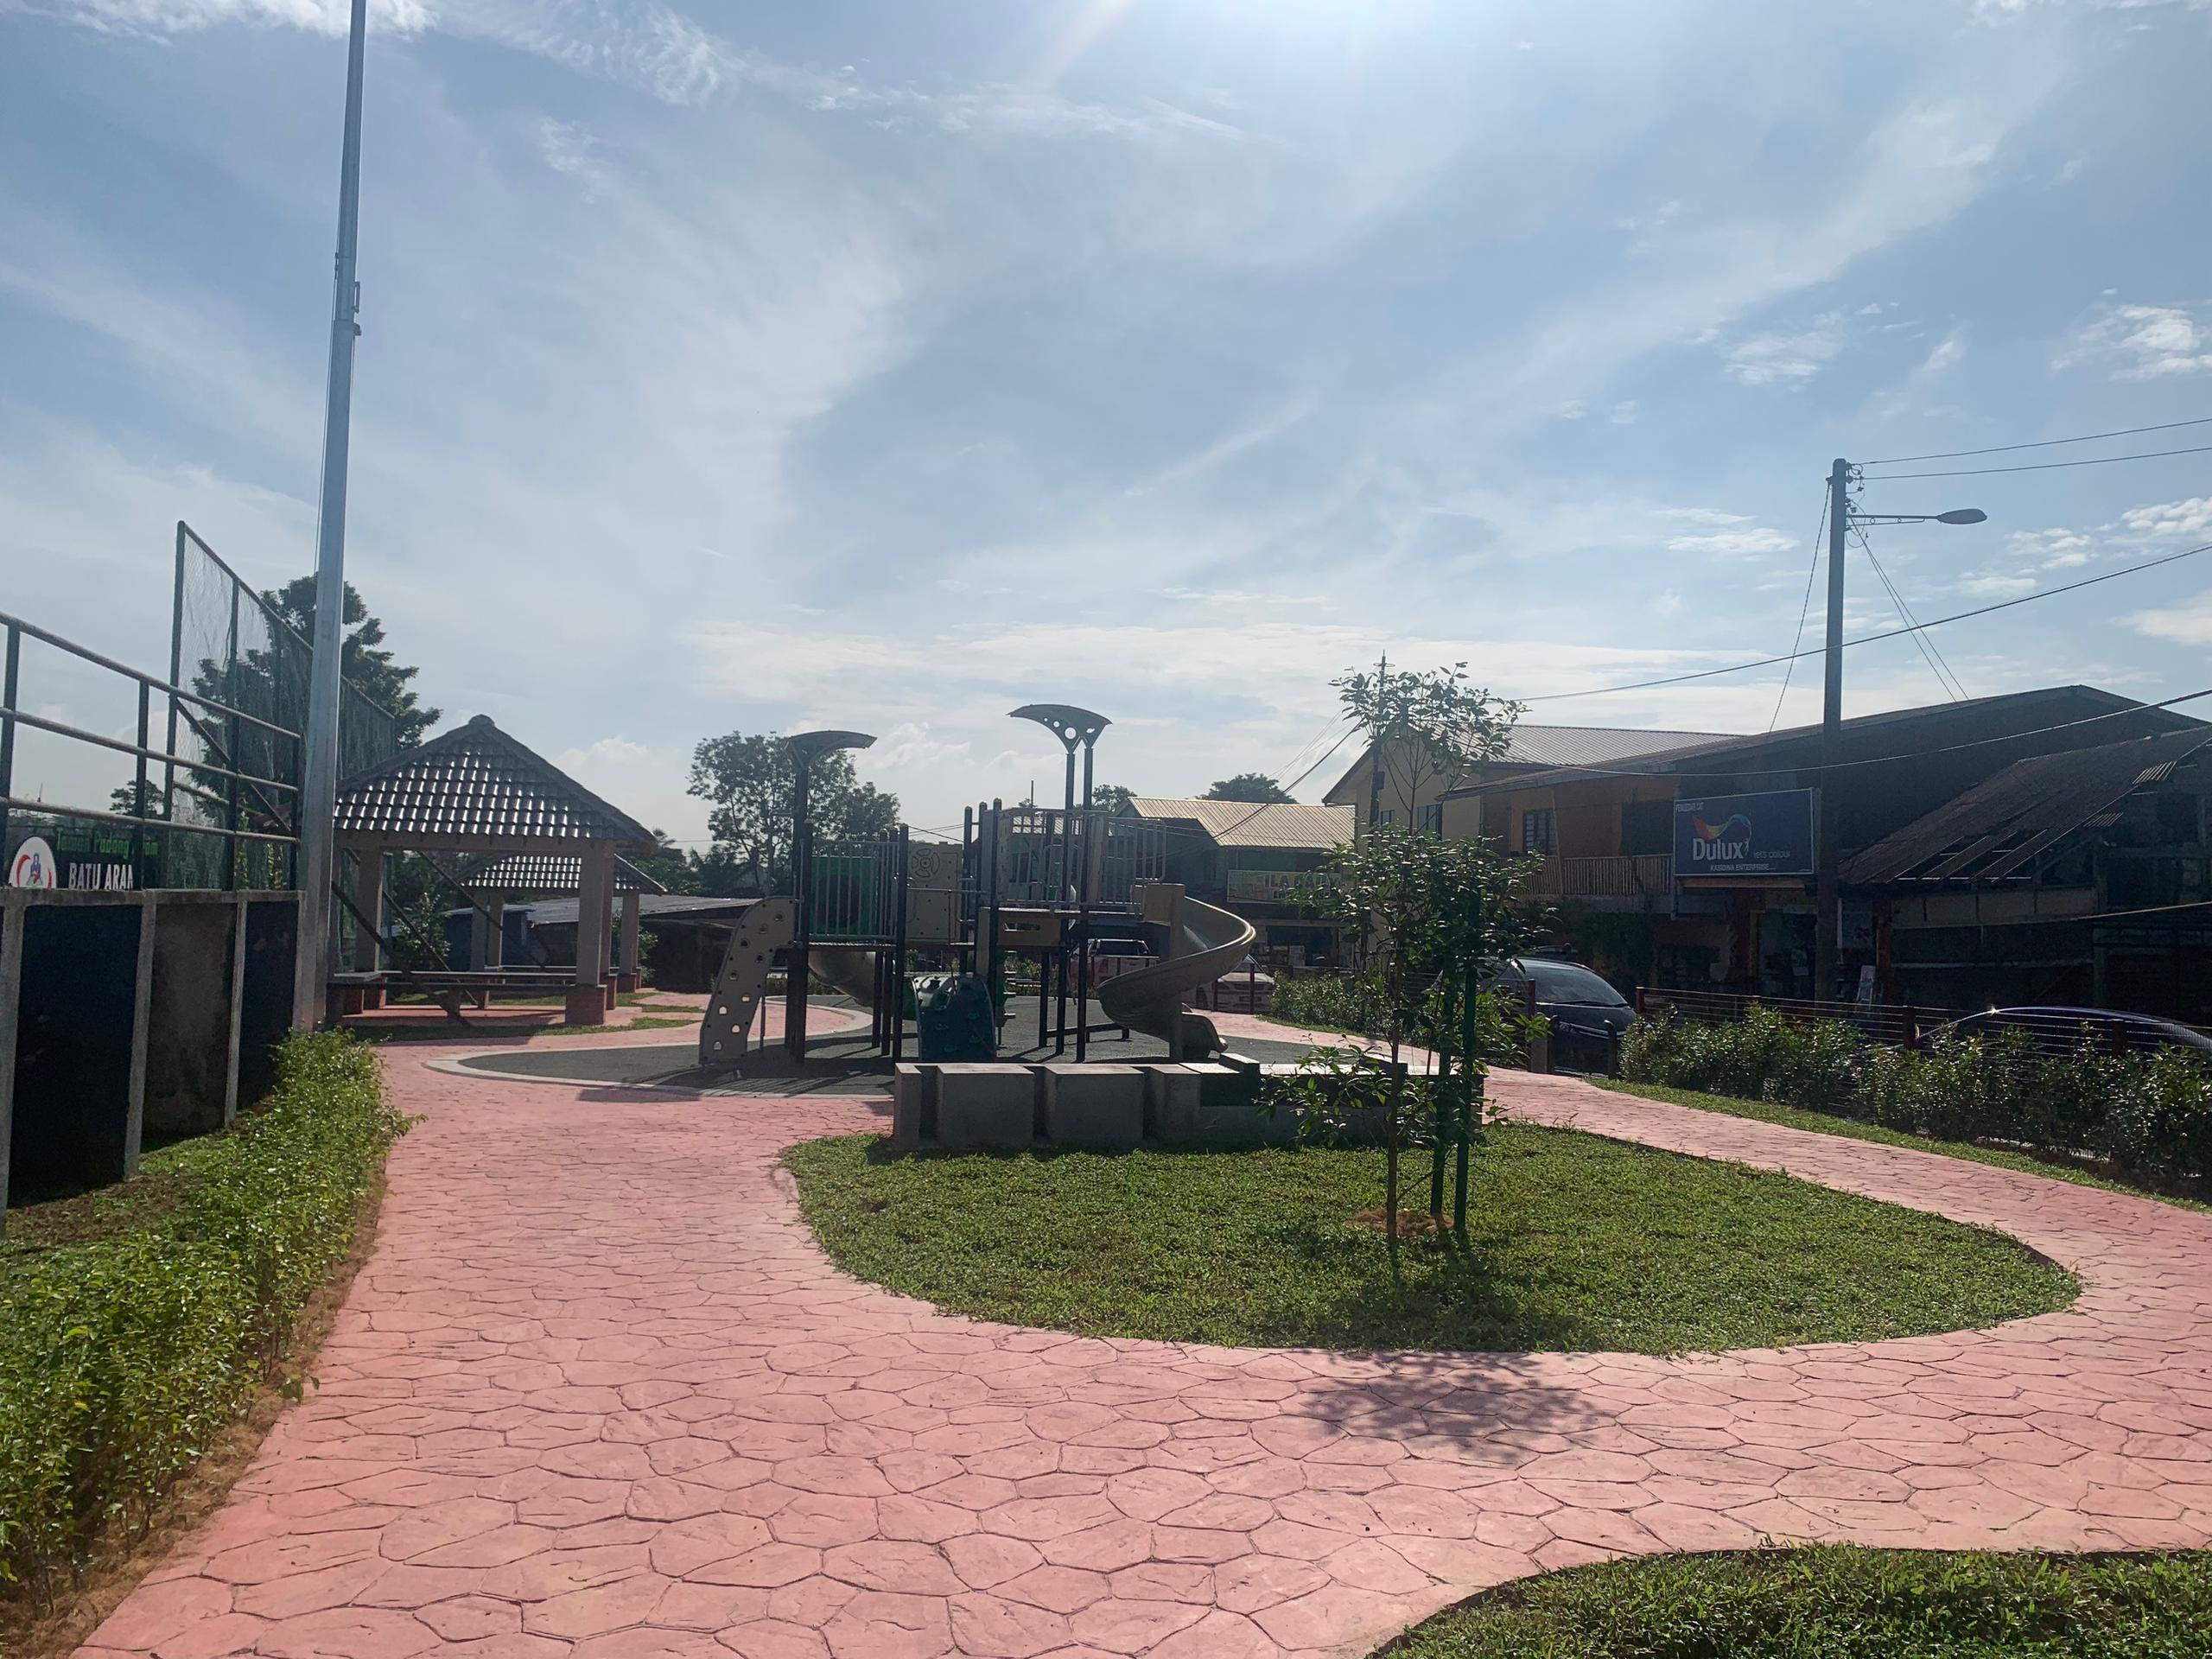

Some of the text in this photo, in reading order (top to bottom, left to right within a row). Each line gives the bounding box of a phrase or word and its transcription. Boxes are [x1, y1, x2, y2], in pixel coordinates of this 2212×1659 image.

[94, 830, 130, 860] Padang
[1693, 838, 1744, 861] Dulux
[68, 862, 101, 890] BATU
